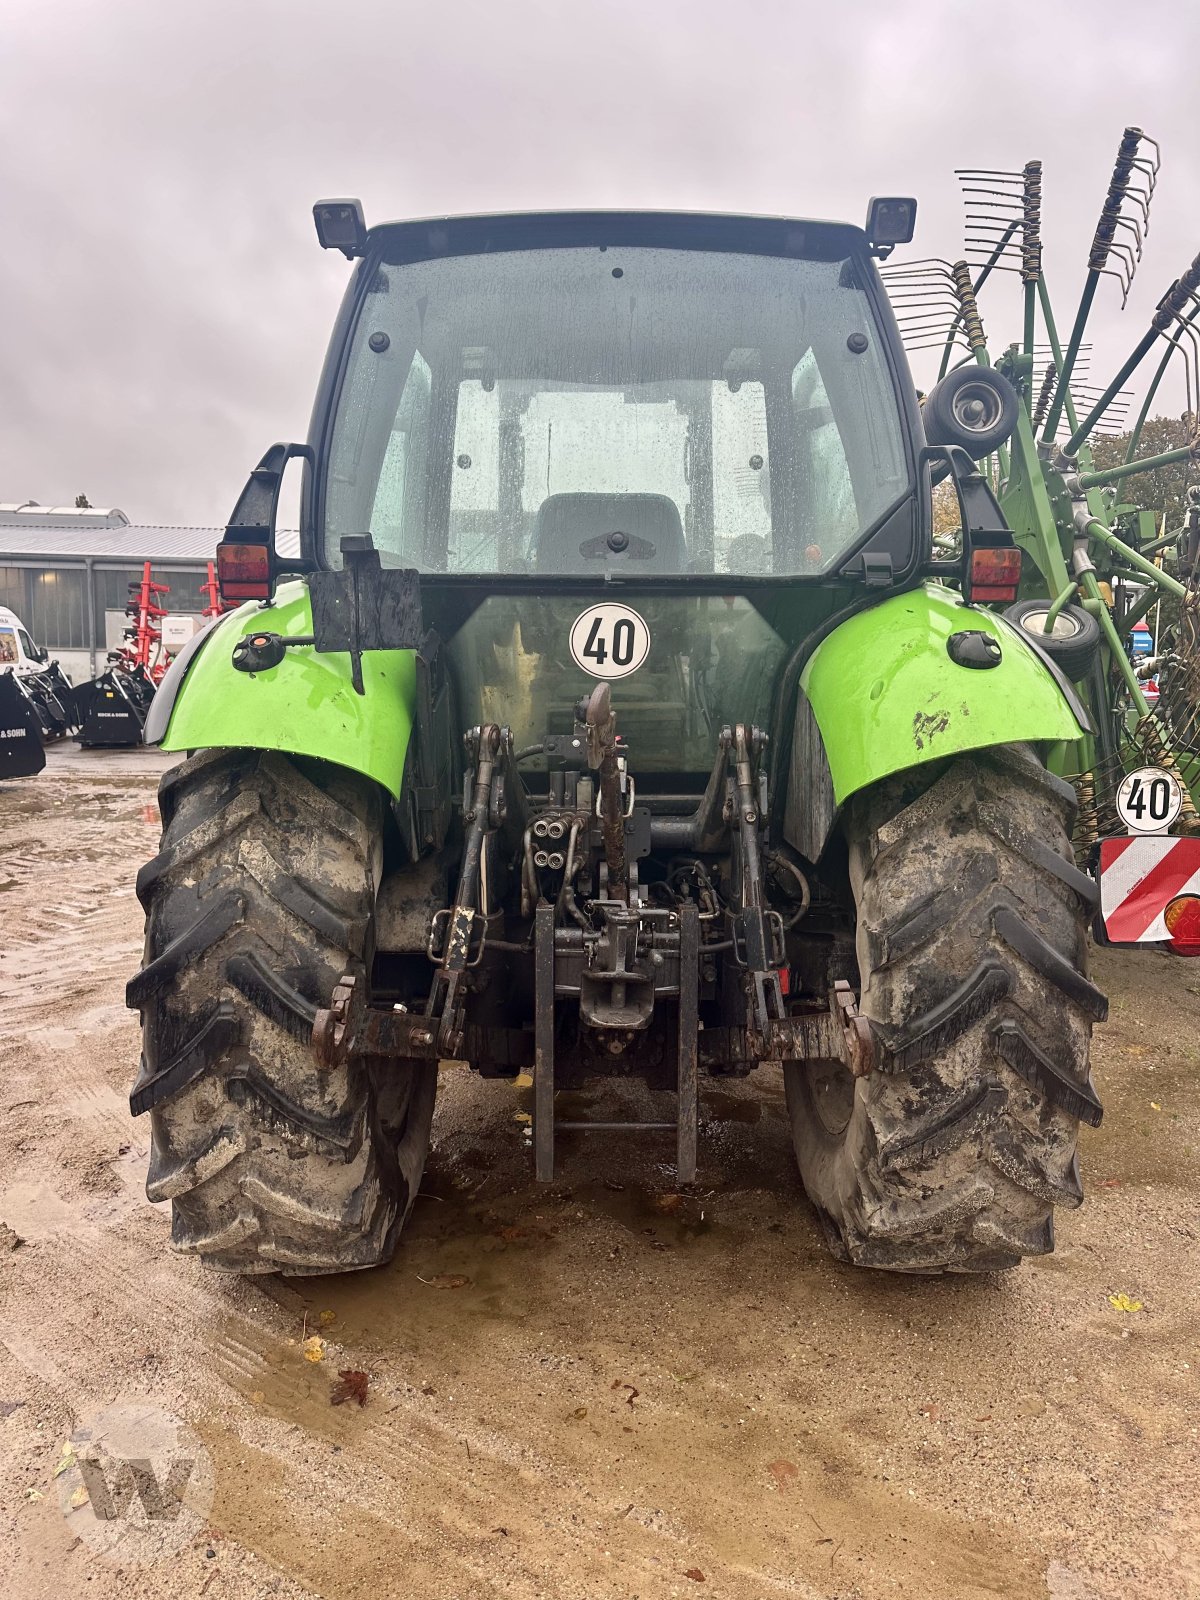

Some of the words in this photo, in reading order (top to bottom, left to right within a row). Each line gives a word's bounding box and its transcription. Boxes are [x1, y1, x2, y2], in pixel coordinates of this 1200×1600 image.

[583, 617, 635, 666] 40
[0, 730, 7, 738] &
[7, 728, 26, 738] SOHN
[1127, 778, 1170, 820] 40
